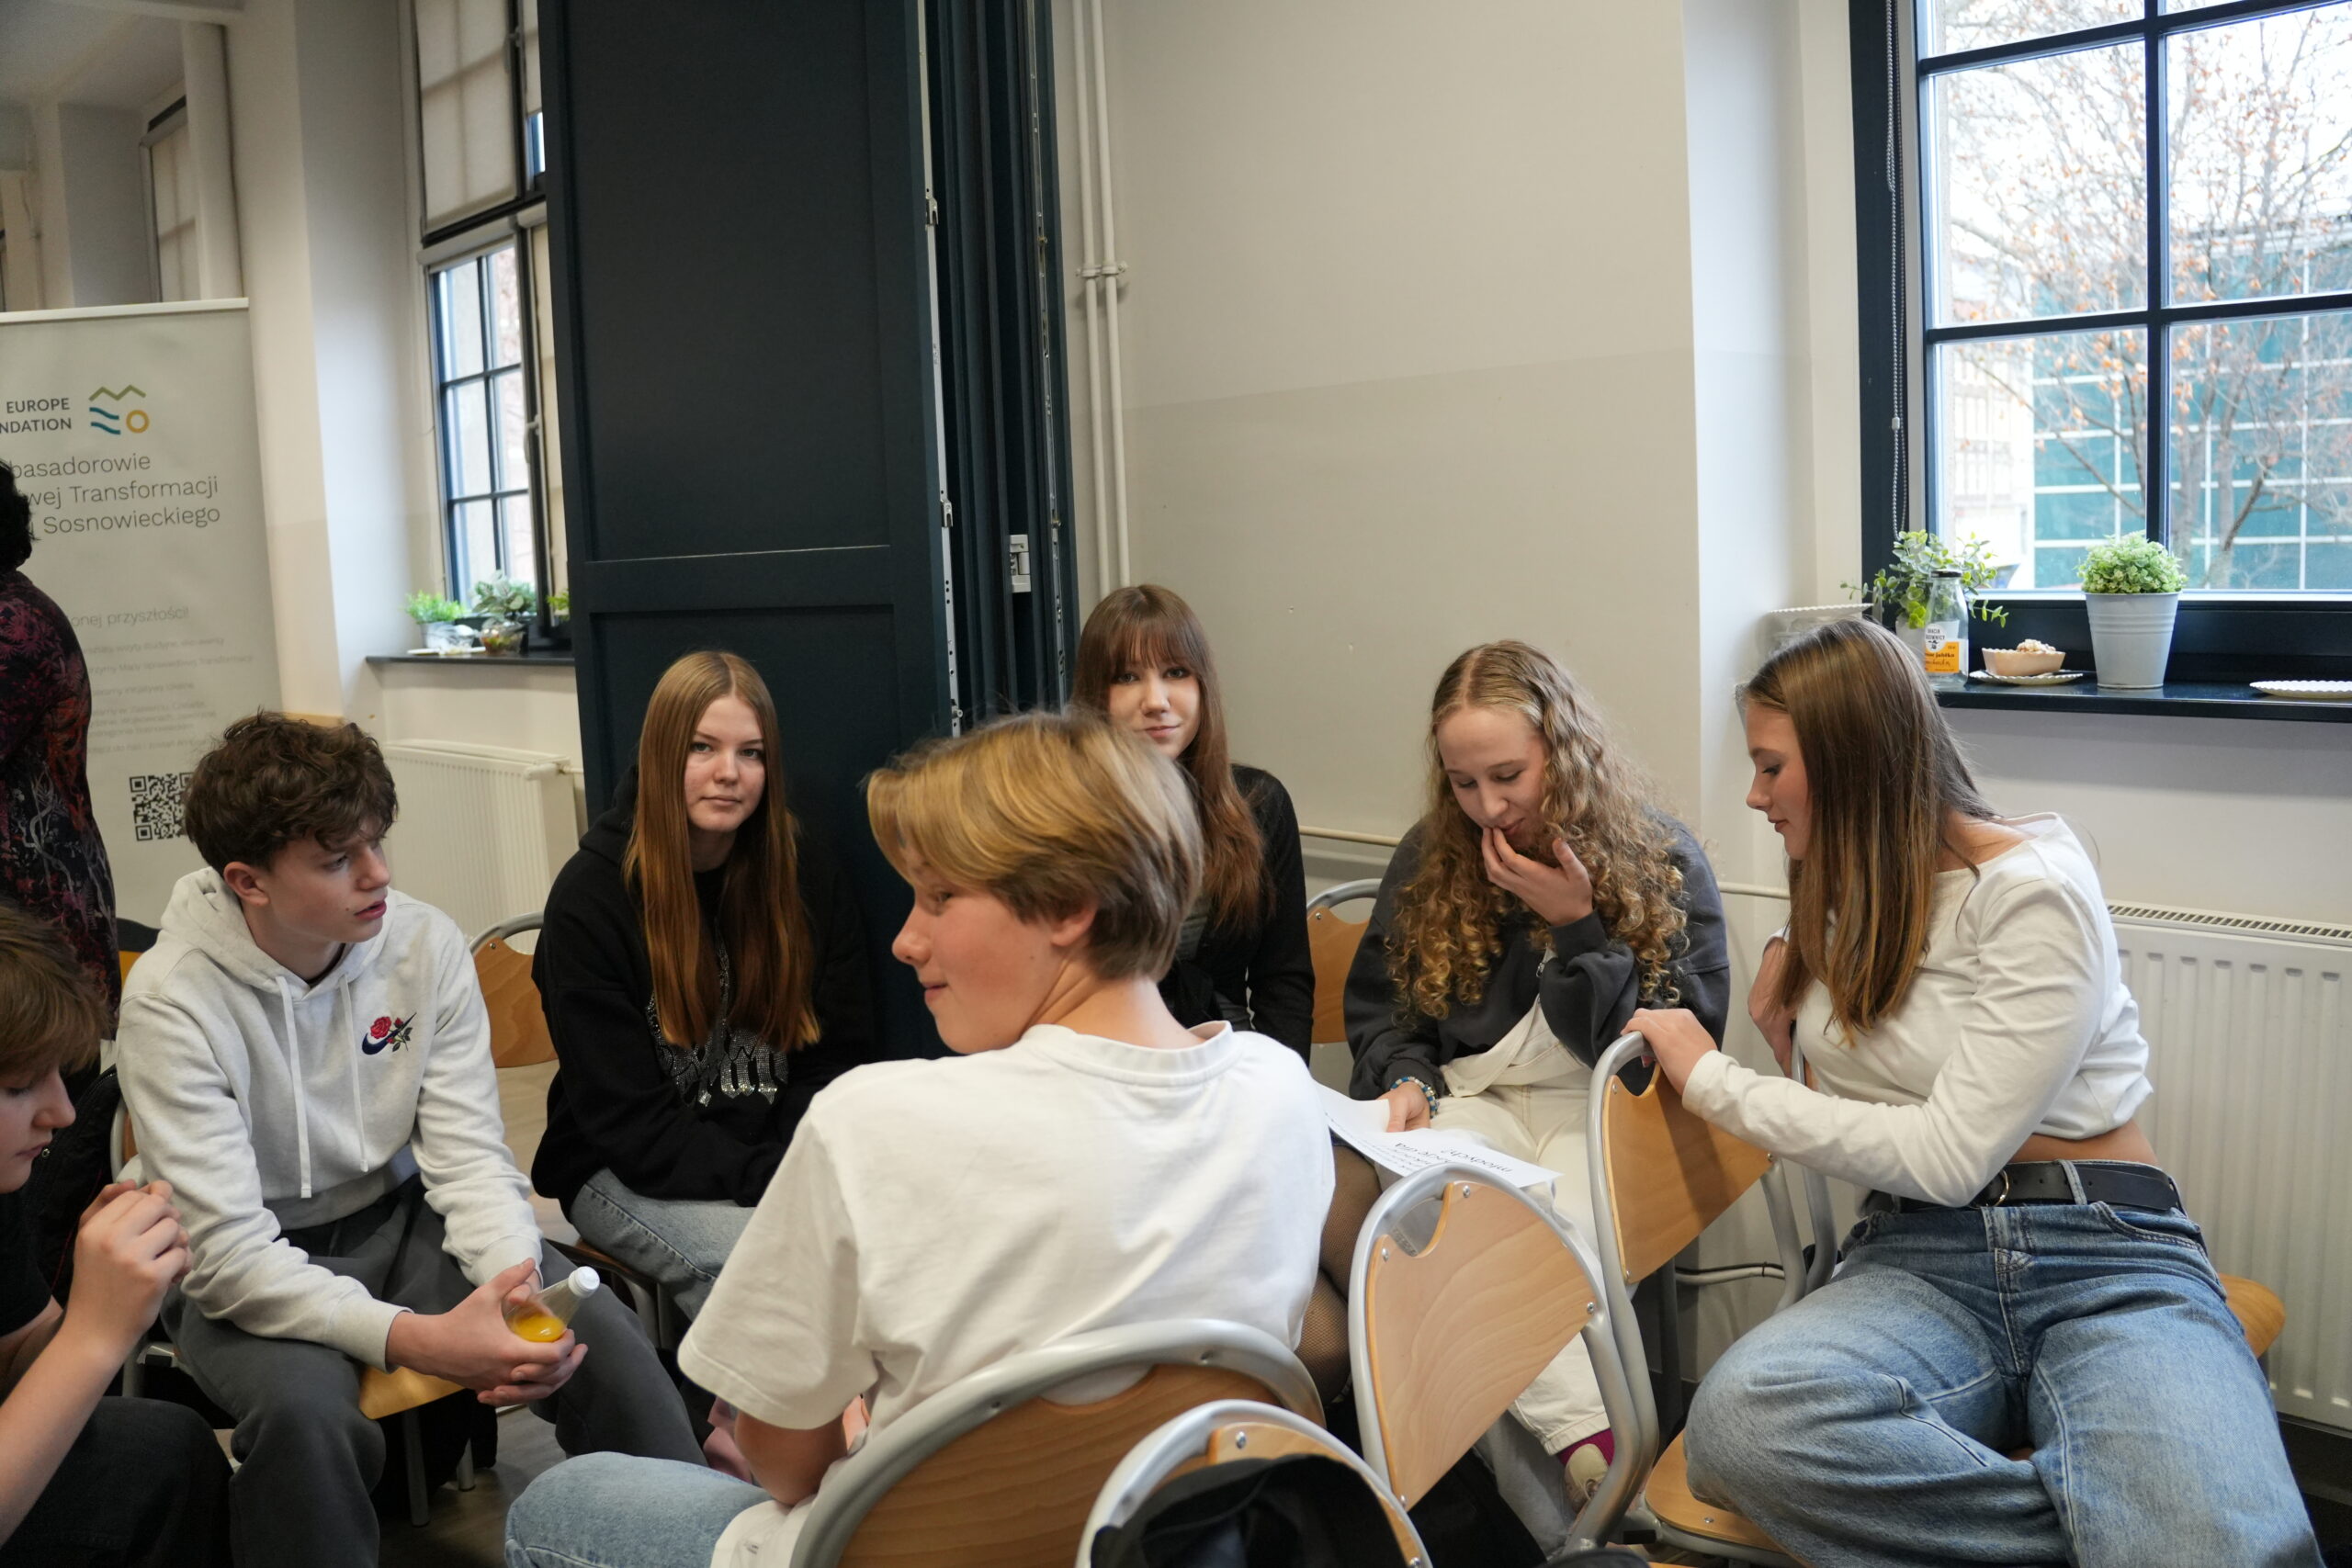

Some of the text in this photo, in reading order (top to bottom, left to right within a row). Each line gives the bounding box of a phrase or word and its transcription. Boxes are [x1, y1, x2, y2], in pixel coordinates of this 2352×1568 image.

[6, 398, 70, 413] EUROPE
[69, 476, 219, 503] Transformacji
[43, 506, 220, 535] Sosnowieckiego
